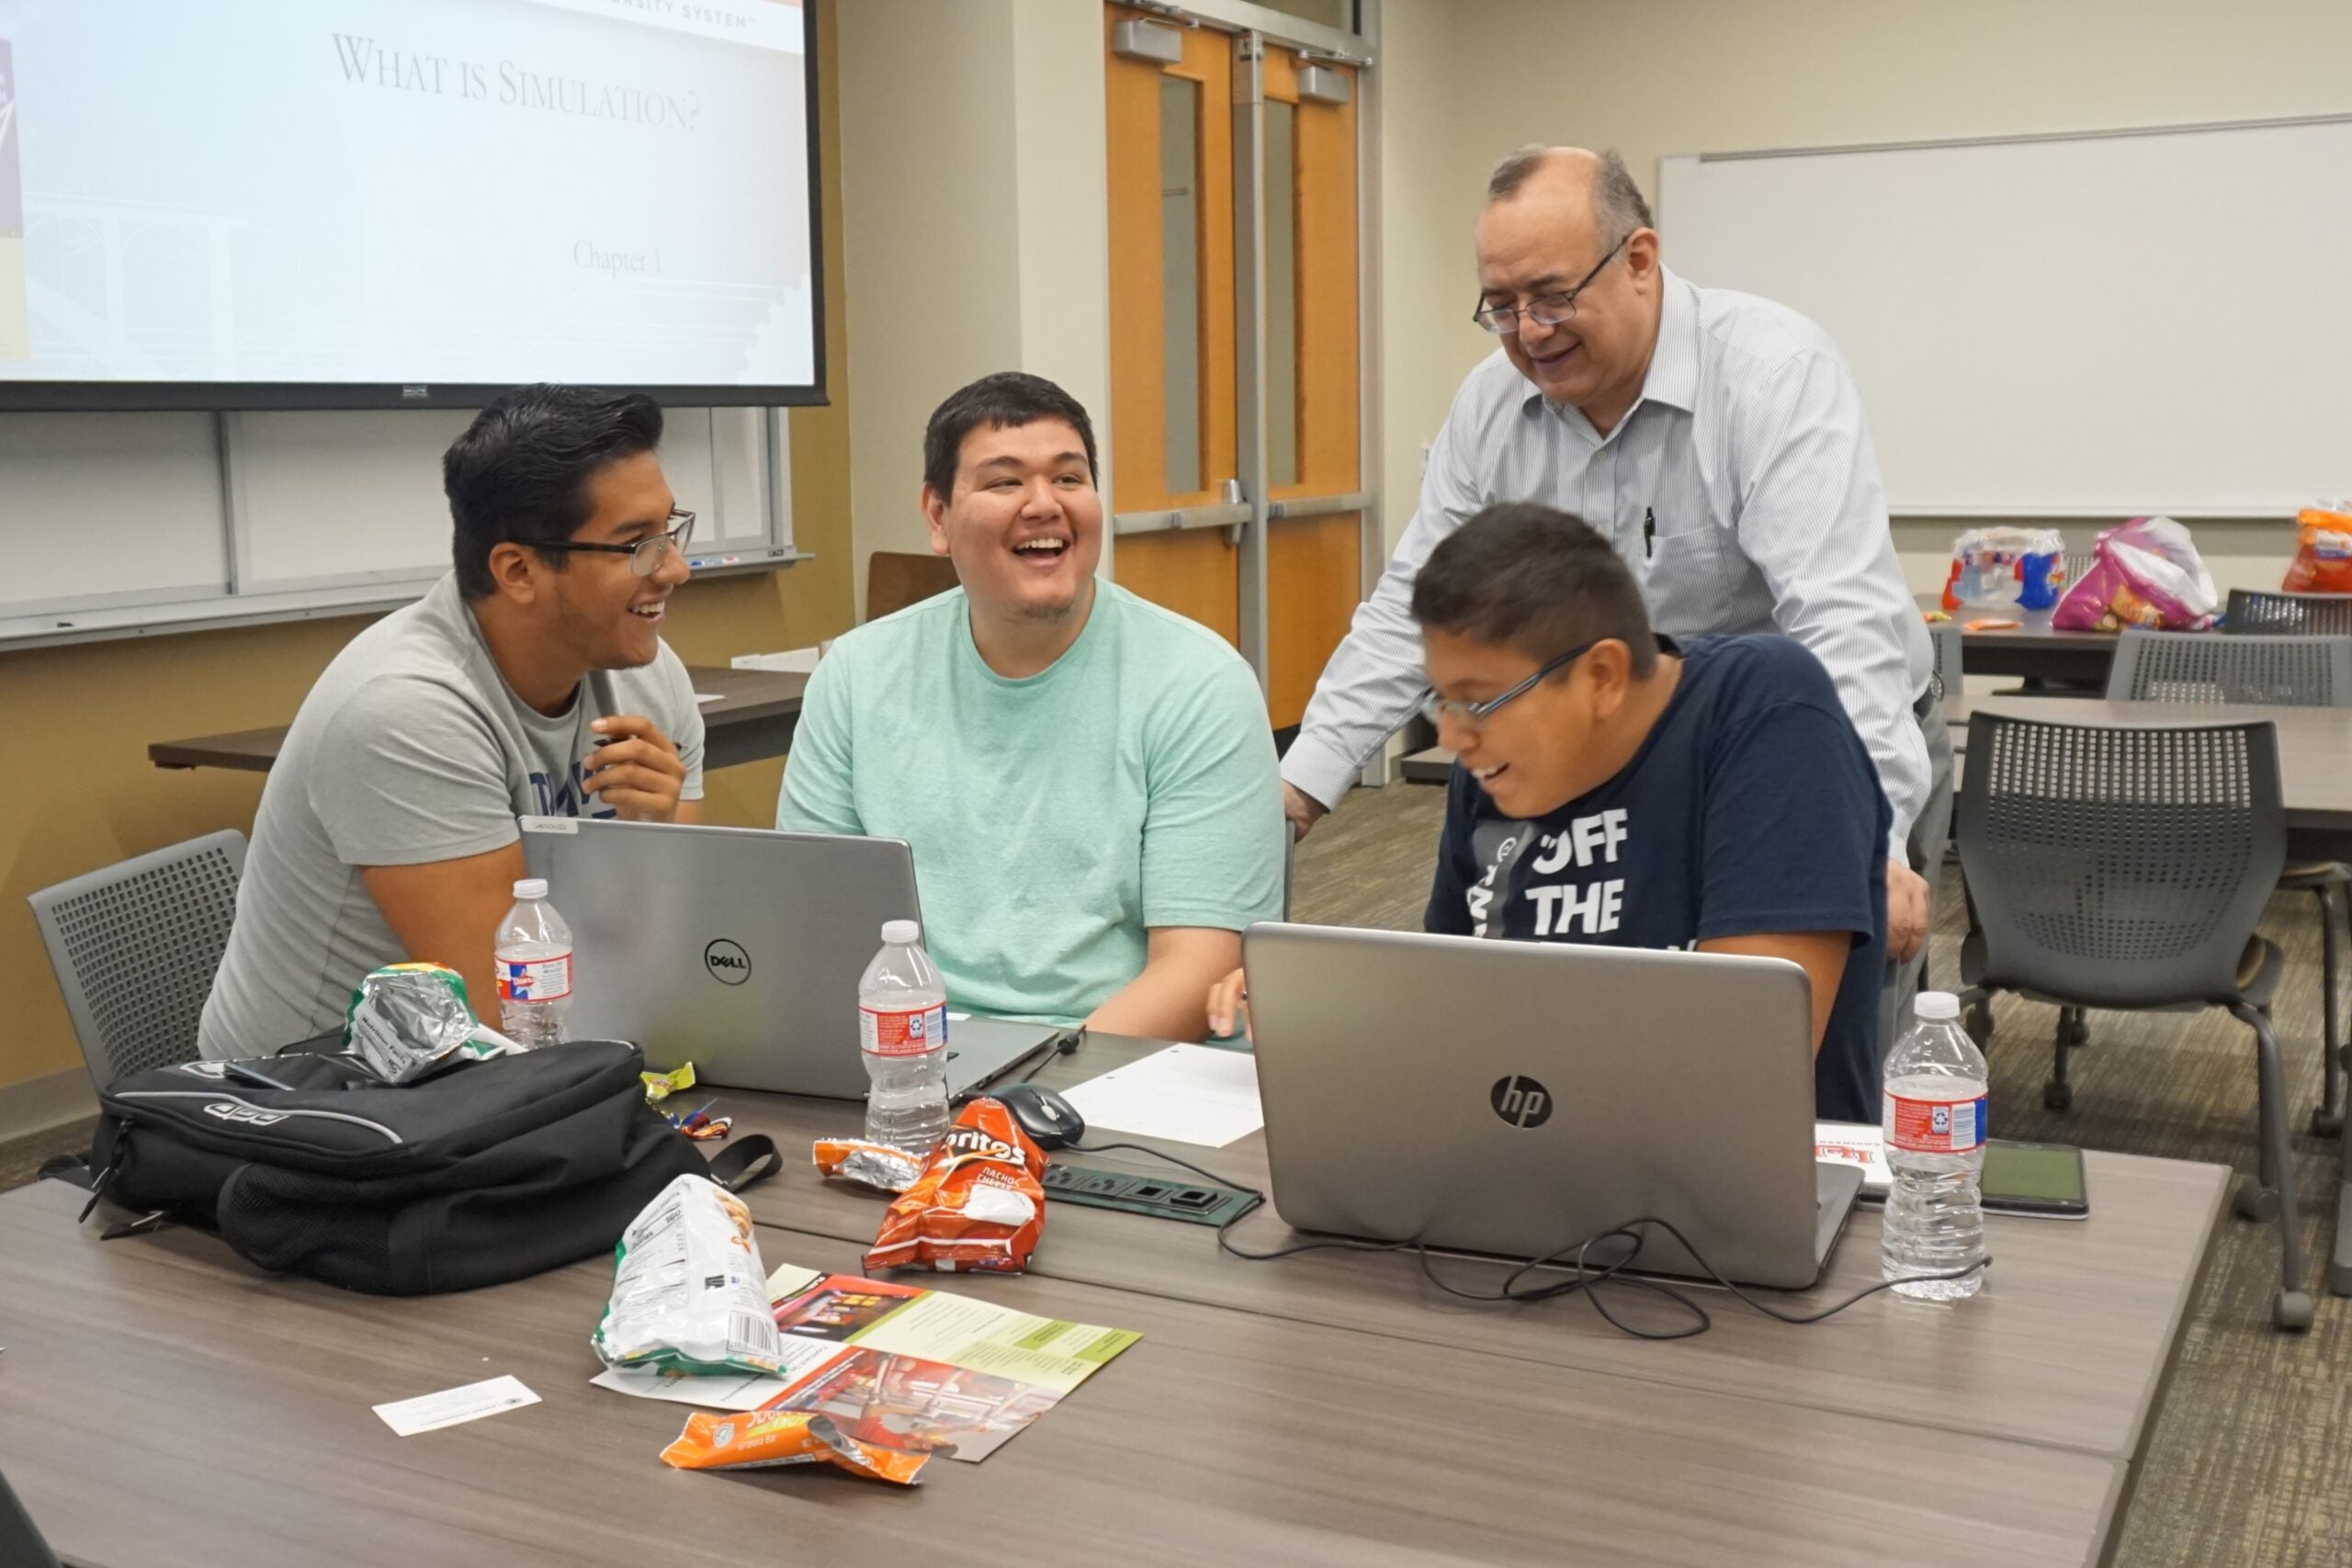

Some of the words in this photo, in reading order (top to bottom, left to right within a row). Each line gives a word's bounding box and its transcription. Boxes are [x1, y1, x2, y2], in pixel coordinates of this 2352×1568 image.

[331, 32, 448, 95] WHAT
[459, 61, 487, 101] IS
[499, 60, 700, 131] SIMULATION?
[573, 239, 648, 279] Chapter
[1524, 878, 1624, 936] THE
[709, 955, 747, 969] DELL
[1499, 1075, 1545, 1128] hp
